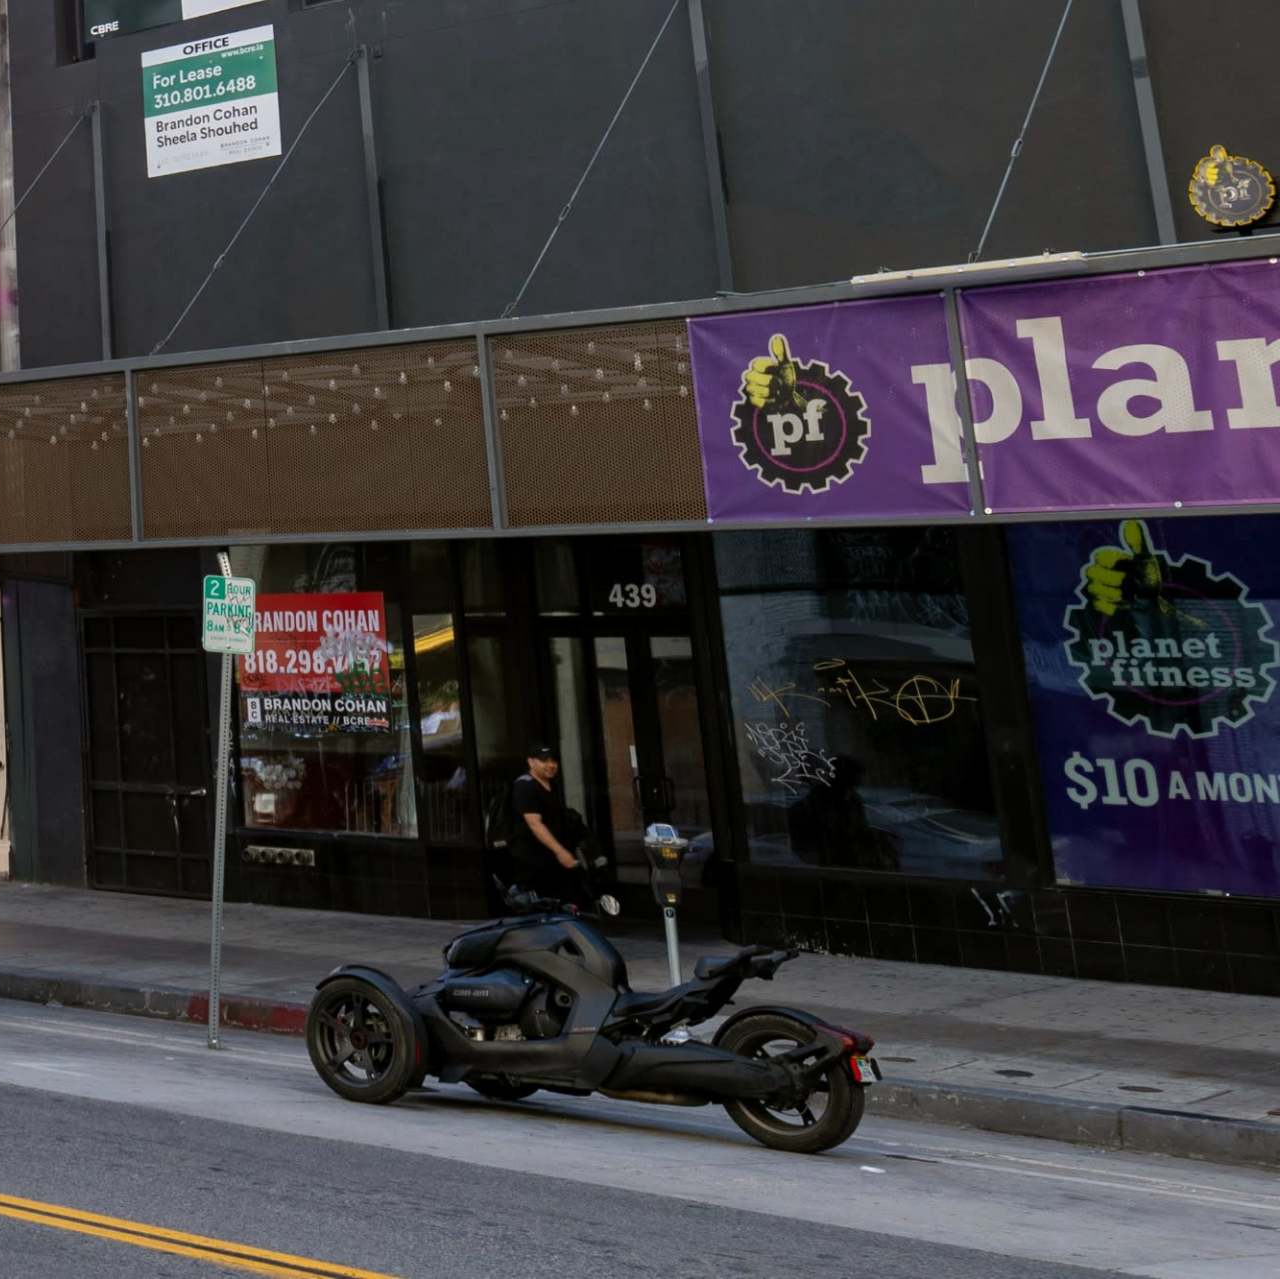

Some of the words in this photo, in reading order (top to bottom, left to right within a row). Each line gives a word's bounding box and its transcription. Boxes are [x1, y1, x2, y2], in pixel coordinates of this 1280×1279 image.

[90, 20, 119, 35] CBRE
[183, 37, 230, 55] OFFICE
[153, 73, 176, 89] For
[179, 65, 223, 83] Lease
[154, 75, 257, 109] 310.801.6488
[156, 114, 210, 133] Brandon
[213, 105, 258, 121] Cohan
[157, 131, 197, 148] Sheela
[200, 119, 259, 140] Shouhed
[767, 398, 828, 458] pf
[210, 580, 220, 596] 2
[608, 584, 656, 608] 439
[207, 602, 252, 617] PARKING
[251, 610, 318, 632] RANDON
[322, 609, 380, 632] COHAN
[1088, 631, 1223, 666] planet
[1110, 658, 1257, 688] fitness
[263, 698, 332, 711] BRANDON
[334, 699, 387, 713] COHAN
[1064, 751, 1160, 809] $10
[1168, 771, 1191, 800] A
[1195, 771, 1280, 804] MON
